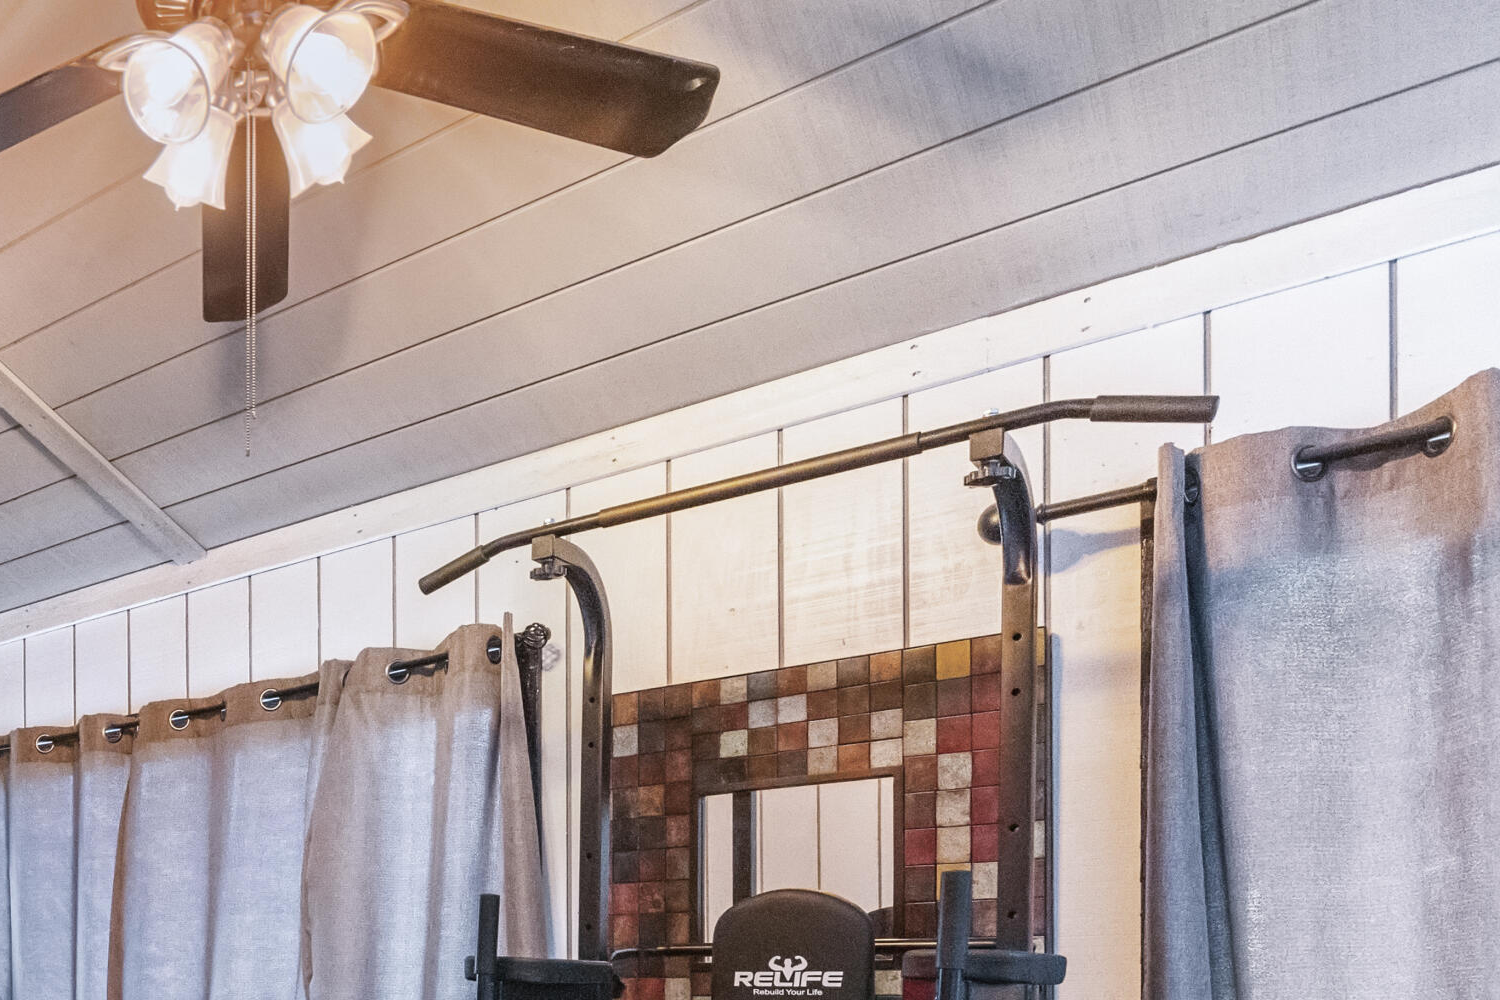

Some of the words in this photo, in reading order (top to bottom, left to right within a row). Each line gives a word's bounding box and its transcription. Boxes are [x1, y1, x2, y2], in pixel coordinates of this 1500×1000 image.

[733, 971, 844, 987] RELIFE
[753, 988, 784, 996] Rebuild
[786, 988, 805, 996] Your
[806, 988, 823, 996] Life
